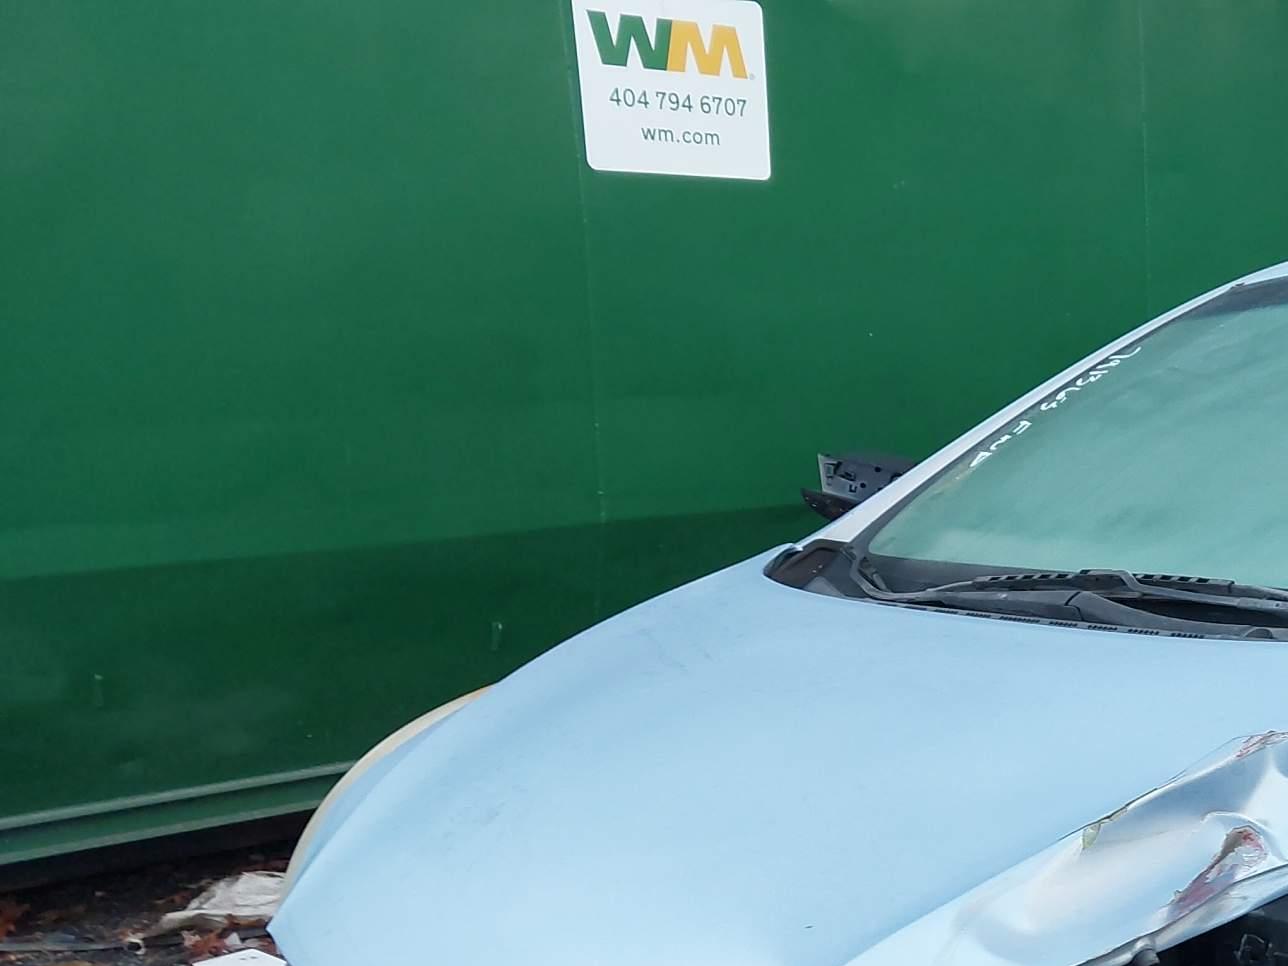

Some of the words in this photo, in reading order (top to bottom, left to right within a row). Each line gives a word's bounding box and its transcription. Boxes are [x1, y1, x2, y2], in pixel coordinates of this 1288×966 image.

[586, 9, 748, 79] WM
[609, 87, 650, 109] 404
[655, 91, 693, 113] 794
[699, 95, 747, 117] 6707
[641, 127, 720, 146] wm.com
